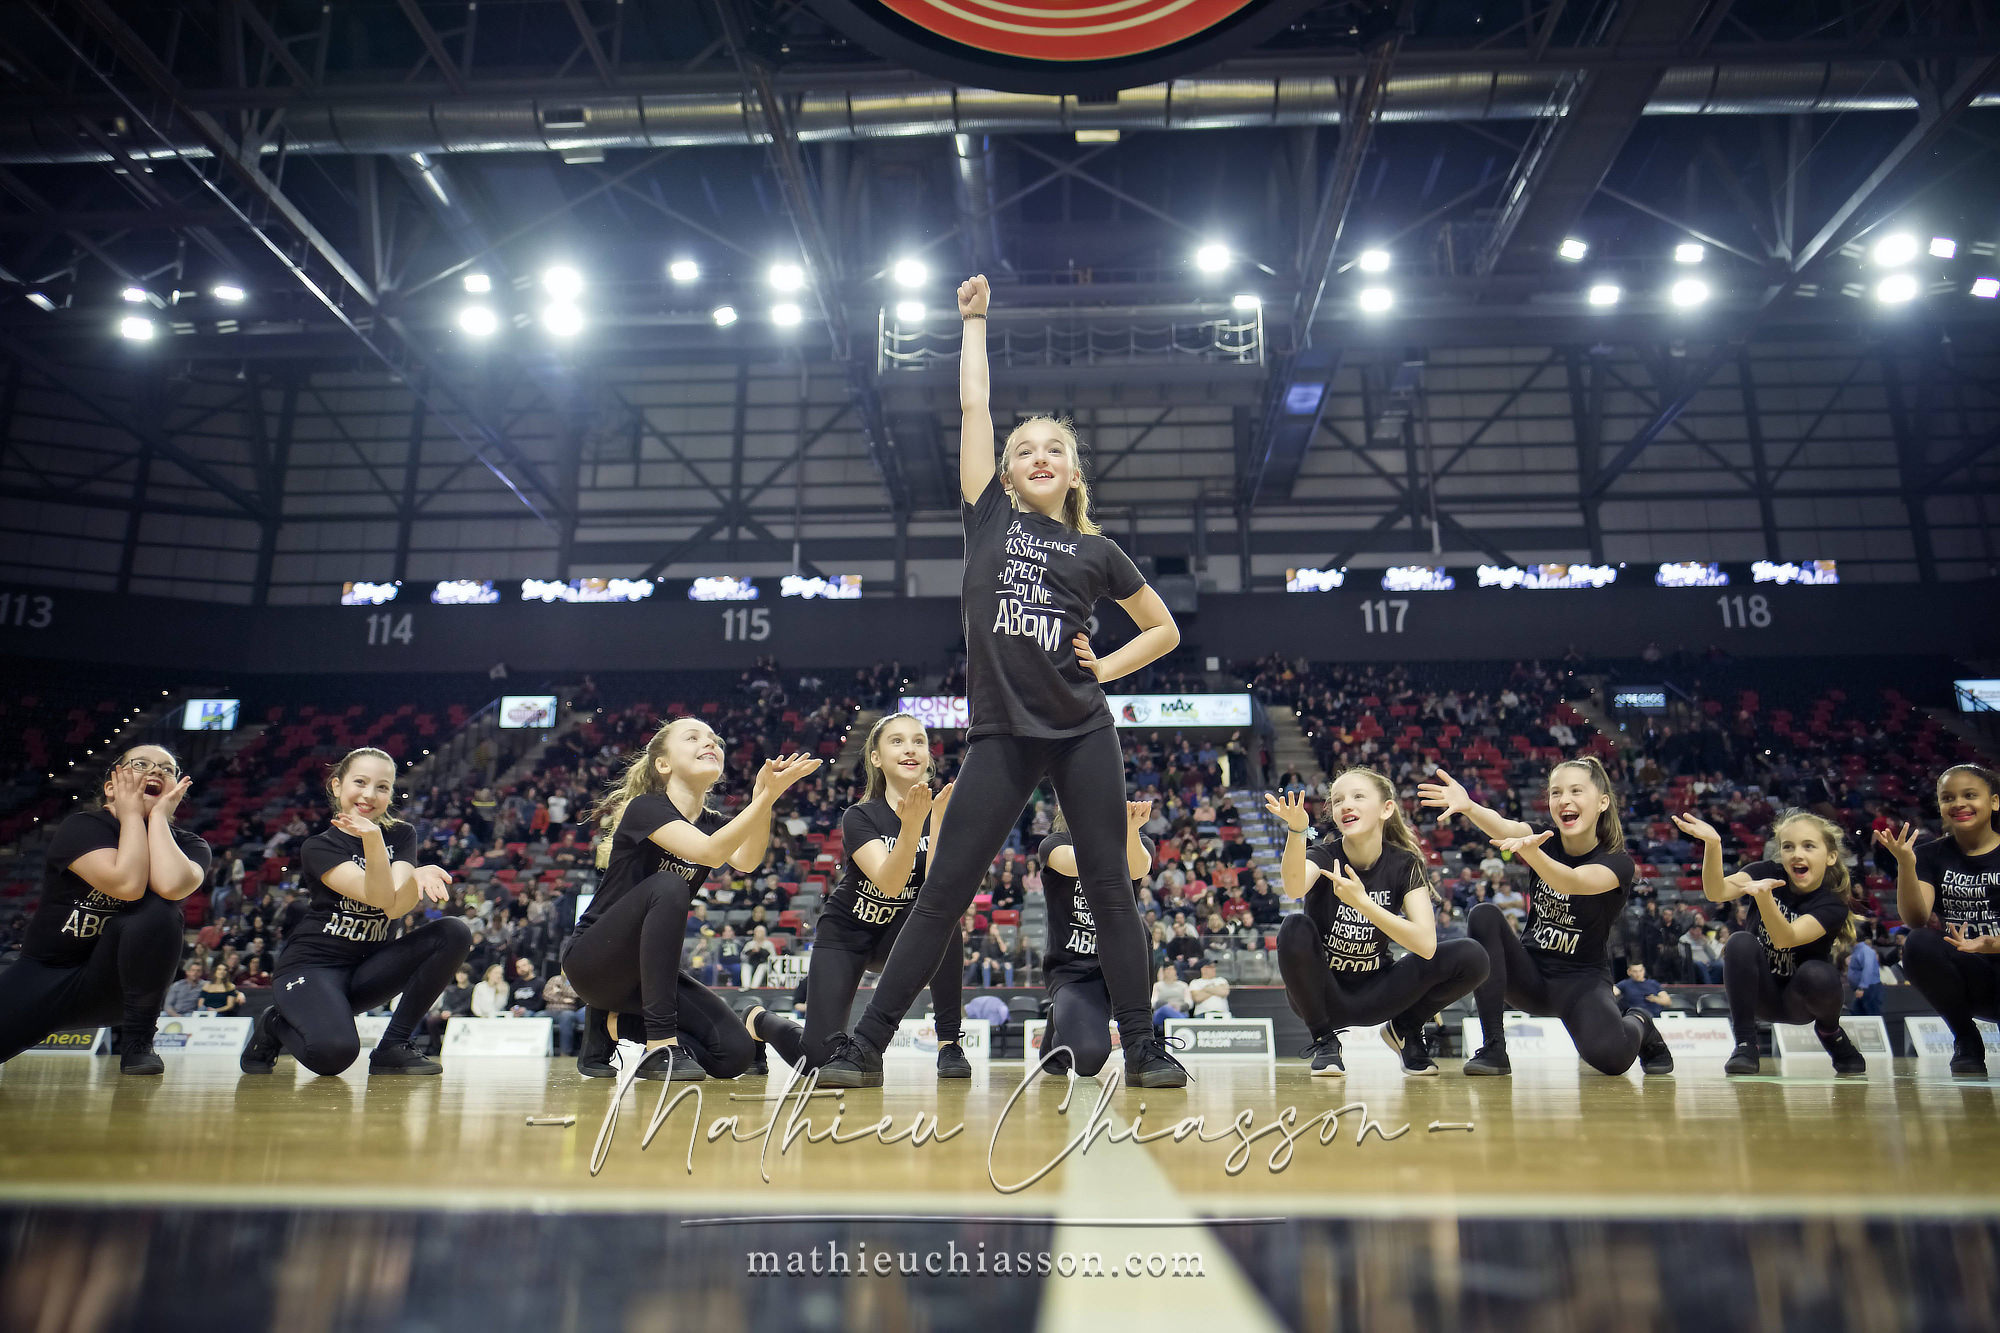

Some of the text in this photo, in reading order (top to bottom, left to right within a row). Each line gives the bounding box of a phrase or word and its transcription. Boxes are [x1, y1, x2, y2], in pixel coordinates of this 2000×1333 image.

[1005, 538, 1047, 563] ASSION
[722, 607, 770, 641] 115
[1360, 599, 1409, 633] 117
[1717, 595, 1771, 628] 118
[367, 613, 414, 645] 114
[1941, 883, 1986, 899] PASSION
[1331, 920, 1375, 940] RESPECT
